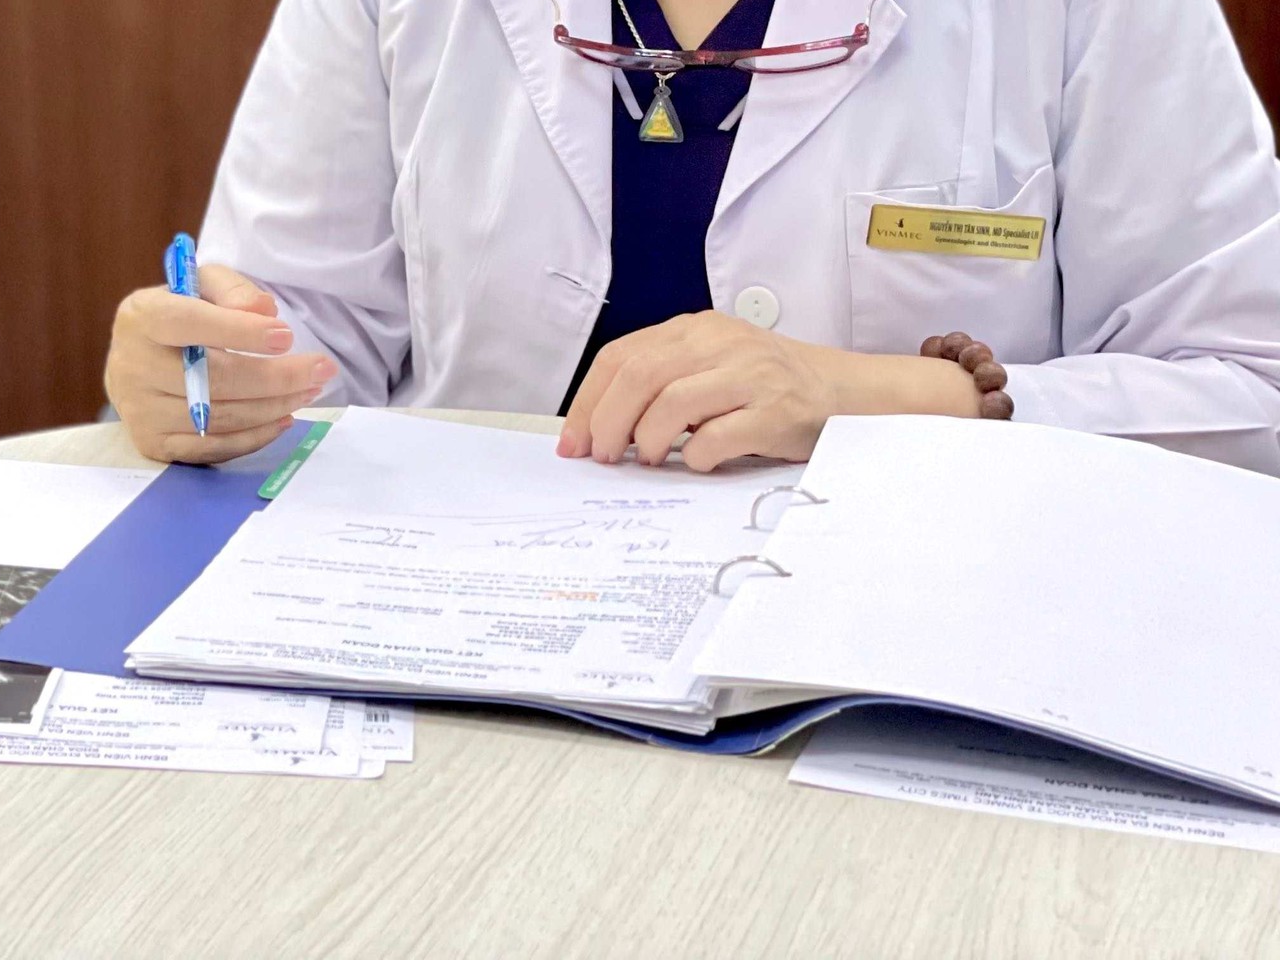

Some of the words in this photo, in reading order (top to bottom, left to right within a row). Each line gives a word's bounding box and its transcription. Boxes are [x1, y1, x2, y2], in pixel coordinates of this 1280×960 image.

[876, 227, 923, 241] VINMEC
[574, 673, 656, 685] VINMEC
[216, 724, 298, 734] VINMEC
[895, 786, 929, 797] CITY
[930, 790, 969, 803] TIMES
[972, 799, 1023, 812] VINMEC
